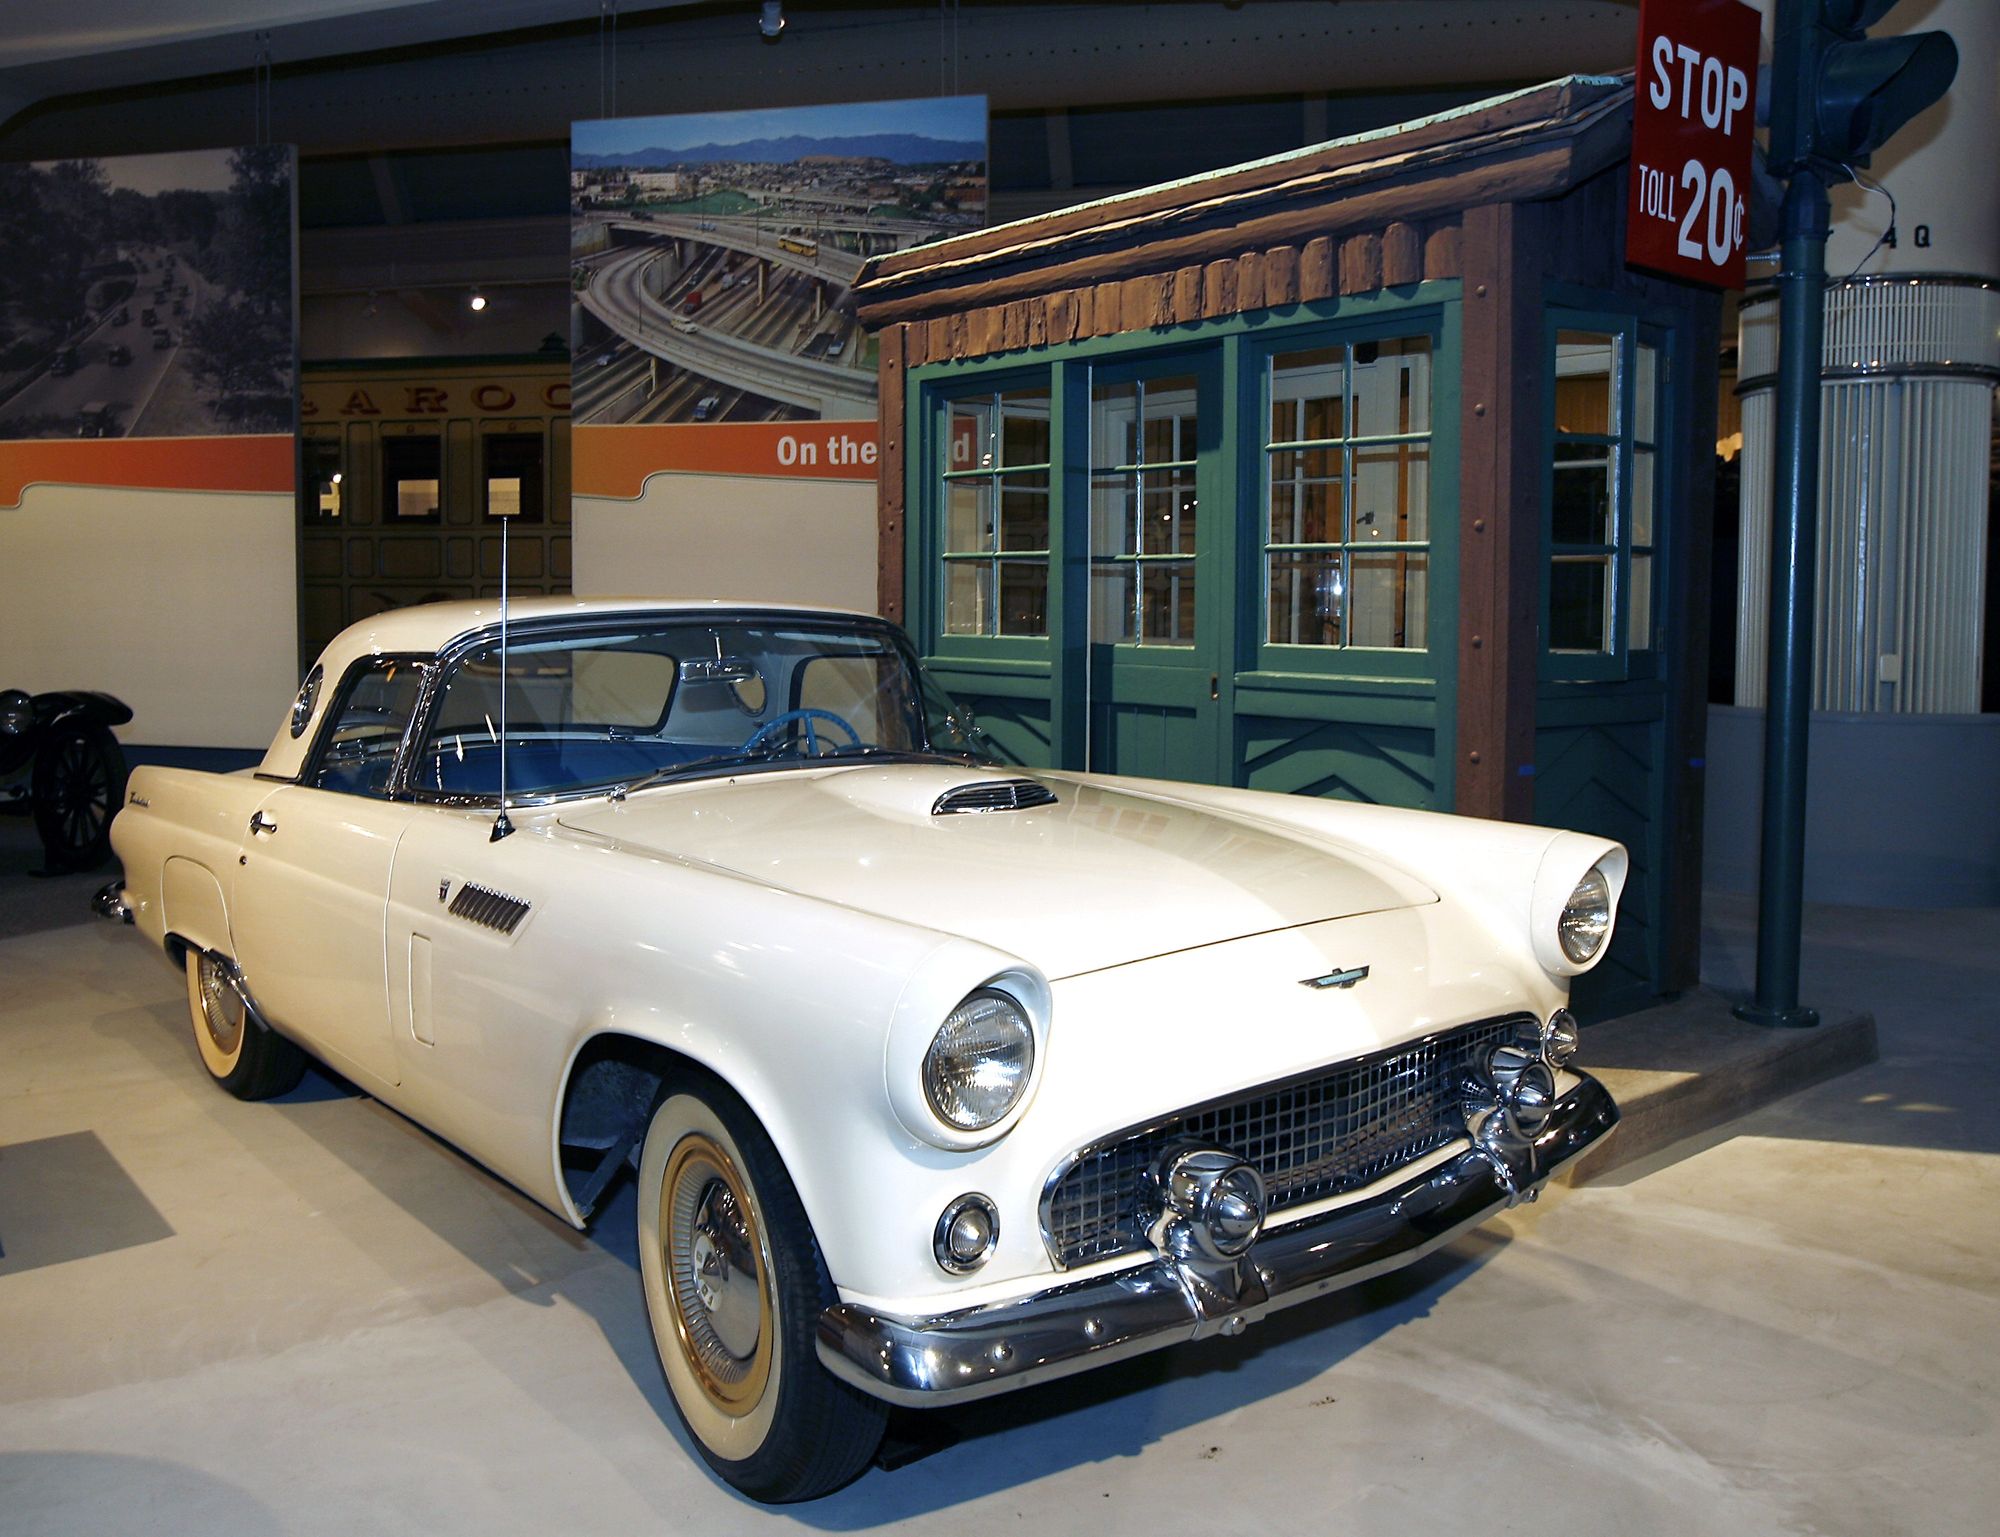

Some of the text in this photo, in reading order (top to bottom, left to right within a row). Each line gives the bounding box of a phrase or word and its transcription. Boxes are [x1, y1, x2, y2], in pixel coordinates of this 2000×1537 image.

[1650, 35, 1748, 136] STOP
[1639, 159, 1745, 266] TOLL 20¢
[776, 435, 878, 466] On the
